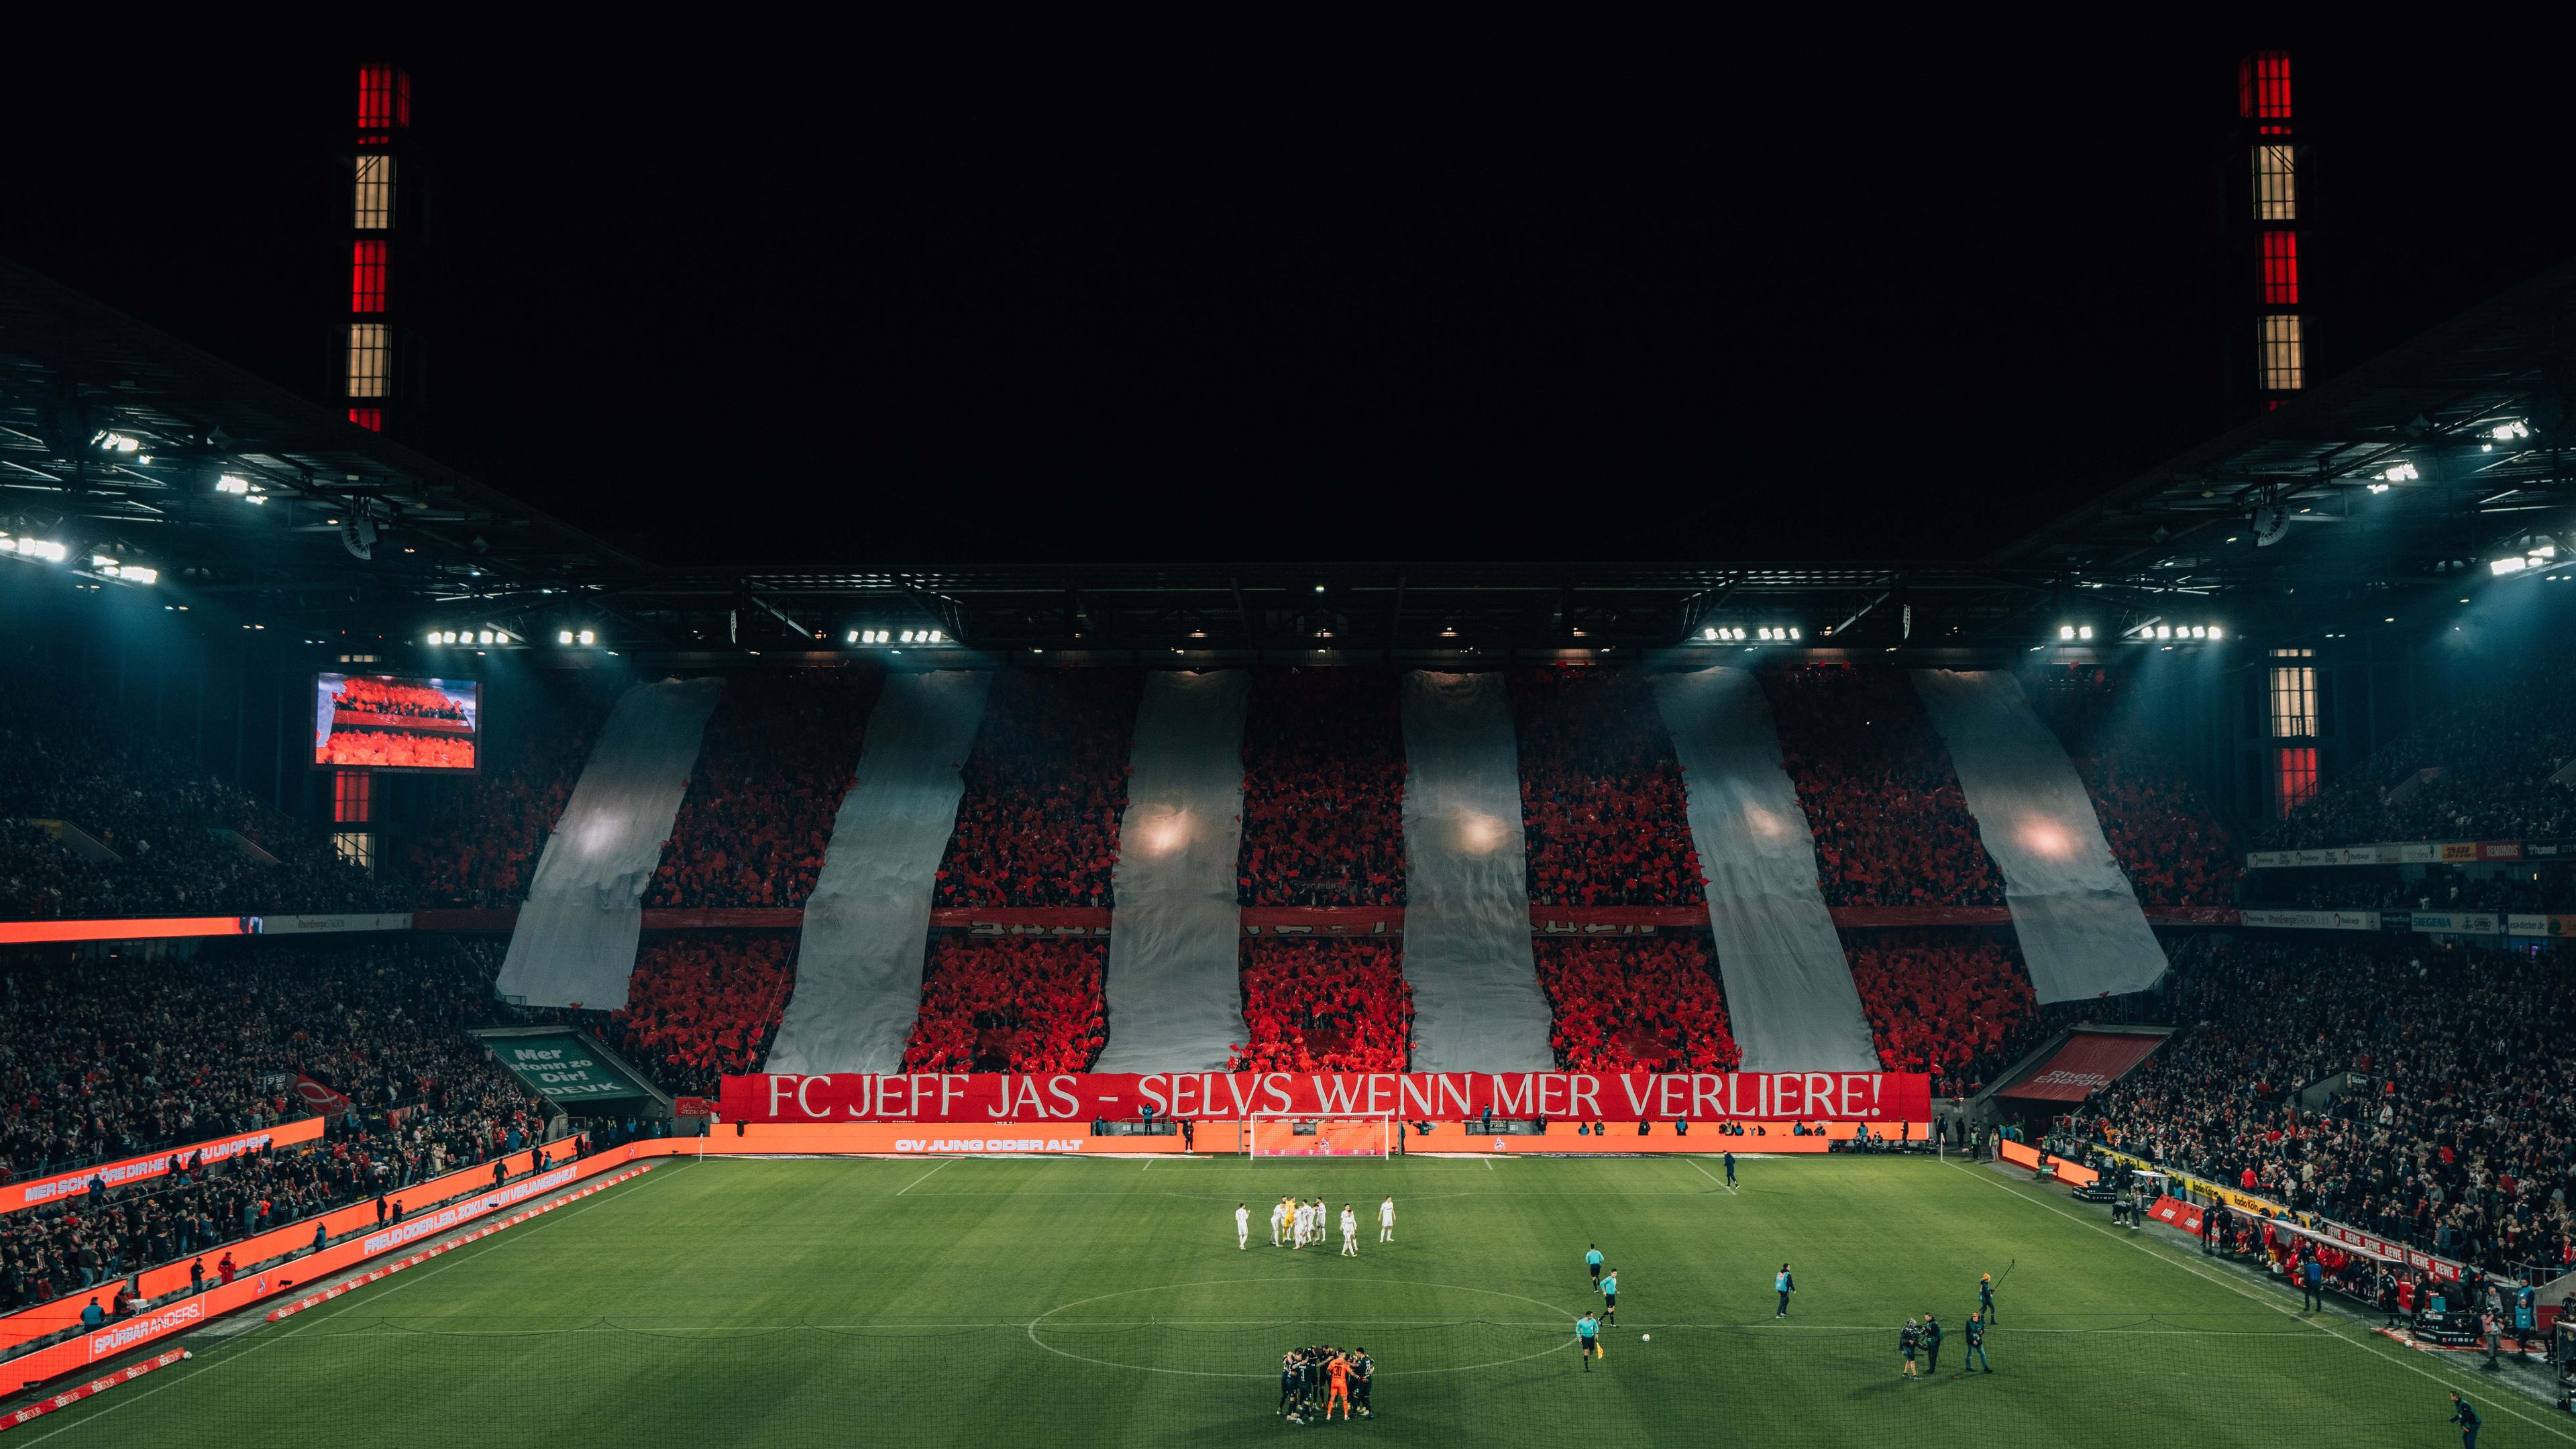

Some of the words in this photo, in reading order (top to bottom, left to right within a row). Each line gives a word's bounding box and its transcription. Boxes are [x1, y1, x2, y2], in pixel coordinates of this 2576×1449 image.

[2487, 845, 2518, 857] REMONDIS
[2535, 843, 2557, 855] hummel
[2414, 917, 2451, 927] SIEGENIA
[515, 1049, 562, 1061] Mer
[539, 1071, 589, 1083] Dir!
[2033, 1075, 2110, 1086] Energie
[2049, 1070, 2105, 1080] Rhein
[541, 1082, 623, 1095] DEVK
[769, 1075, 830, 1117] FC
[849, 1073, 969, 1118] JEFF
[988, 1075, 1079, 1118] JAS
[1138, 1073, 1293, 1116] SELVS
[1312, 1073, 1471, 1116] WENN
[1491, 1073, 1603, 1116] MER
[1620, 1073, 1882, 1117] VERLIERE!
[896, 1139, 926, 1151] OV
[928, 1139, 984, 1151] JUNG
[986, 1139, 1044, 1151] ODER
[1046, 1139, 1083, 1151] ALT
[25, 1181, 56, 1202] MER
[126, 1161, 148, 1177] DIR
[148, 1157, 165, 1173] HE
[184, 1145, 213, 1164] TEU
[213, 1142, 229, 1159] UN
[230, 1139, 246, 1153] OP
[2193, 1181, 2205, 1193] Radio
[2234, 1195, 2247, 1208] Radio
[2247, 1199, 2259, 1211] Köln
[364, 1228, 403, 1255] FREUD
[403, 1219, 433, 1240] ODER
[434, 1210, 458, 1229] LEID,
[2326, 1224, 2341, 1240] REWE
[2345, 1231, 2361, 1246] REWE
[2364, 1238, 2381, 1254] REWE
[2384, 1244, 2402, 1260] REWE
[2411, 1252, 2429, 1269] REWE
[2434, 1261, 2455, 1278] REWE
[95, 1320, 148, 1354] SPÜRBAR
[150, 1303, 200, 1334] ANDERS.
[1300, 1368, 1305, 1379] 3
[1334, 1366, 1342, 1377] 30
[91, 1378, 117, 1393] DERTOUR
[56, 1392, 81, 1408] DERTOUR
[16, 1407, 43, 1423] DERTOUR
